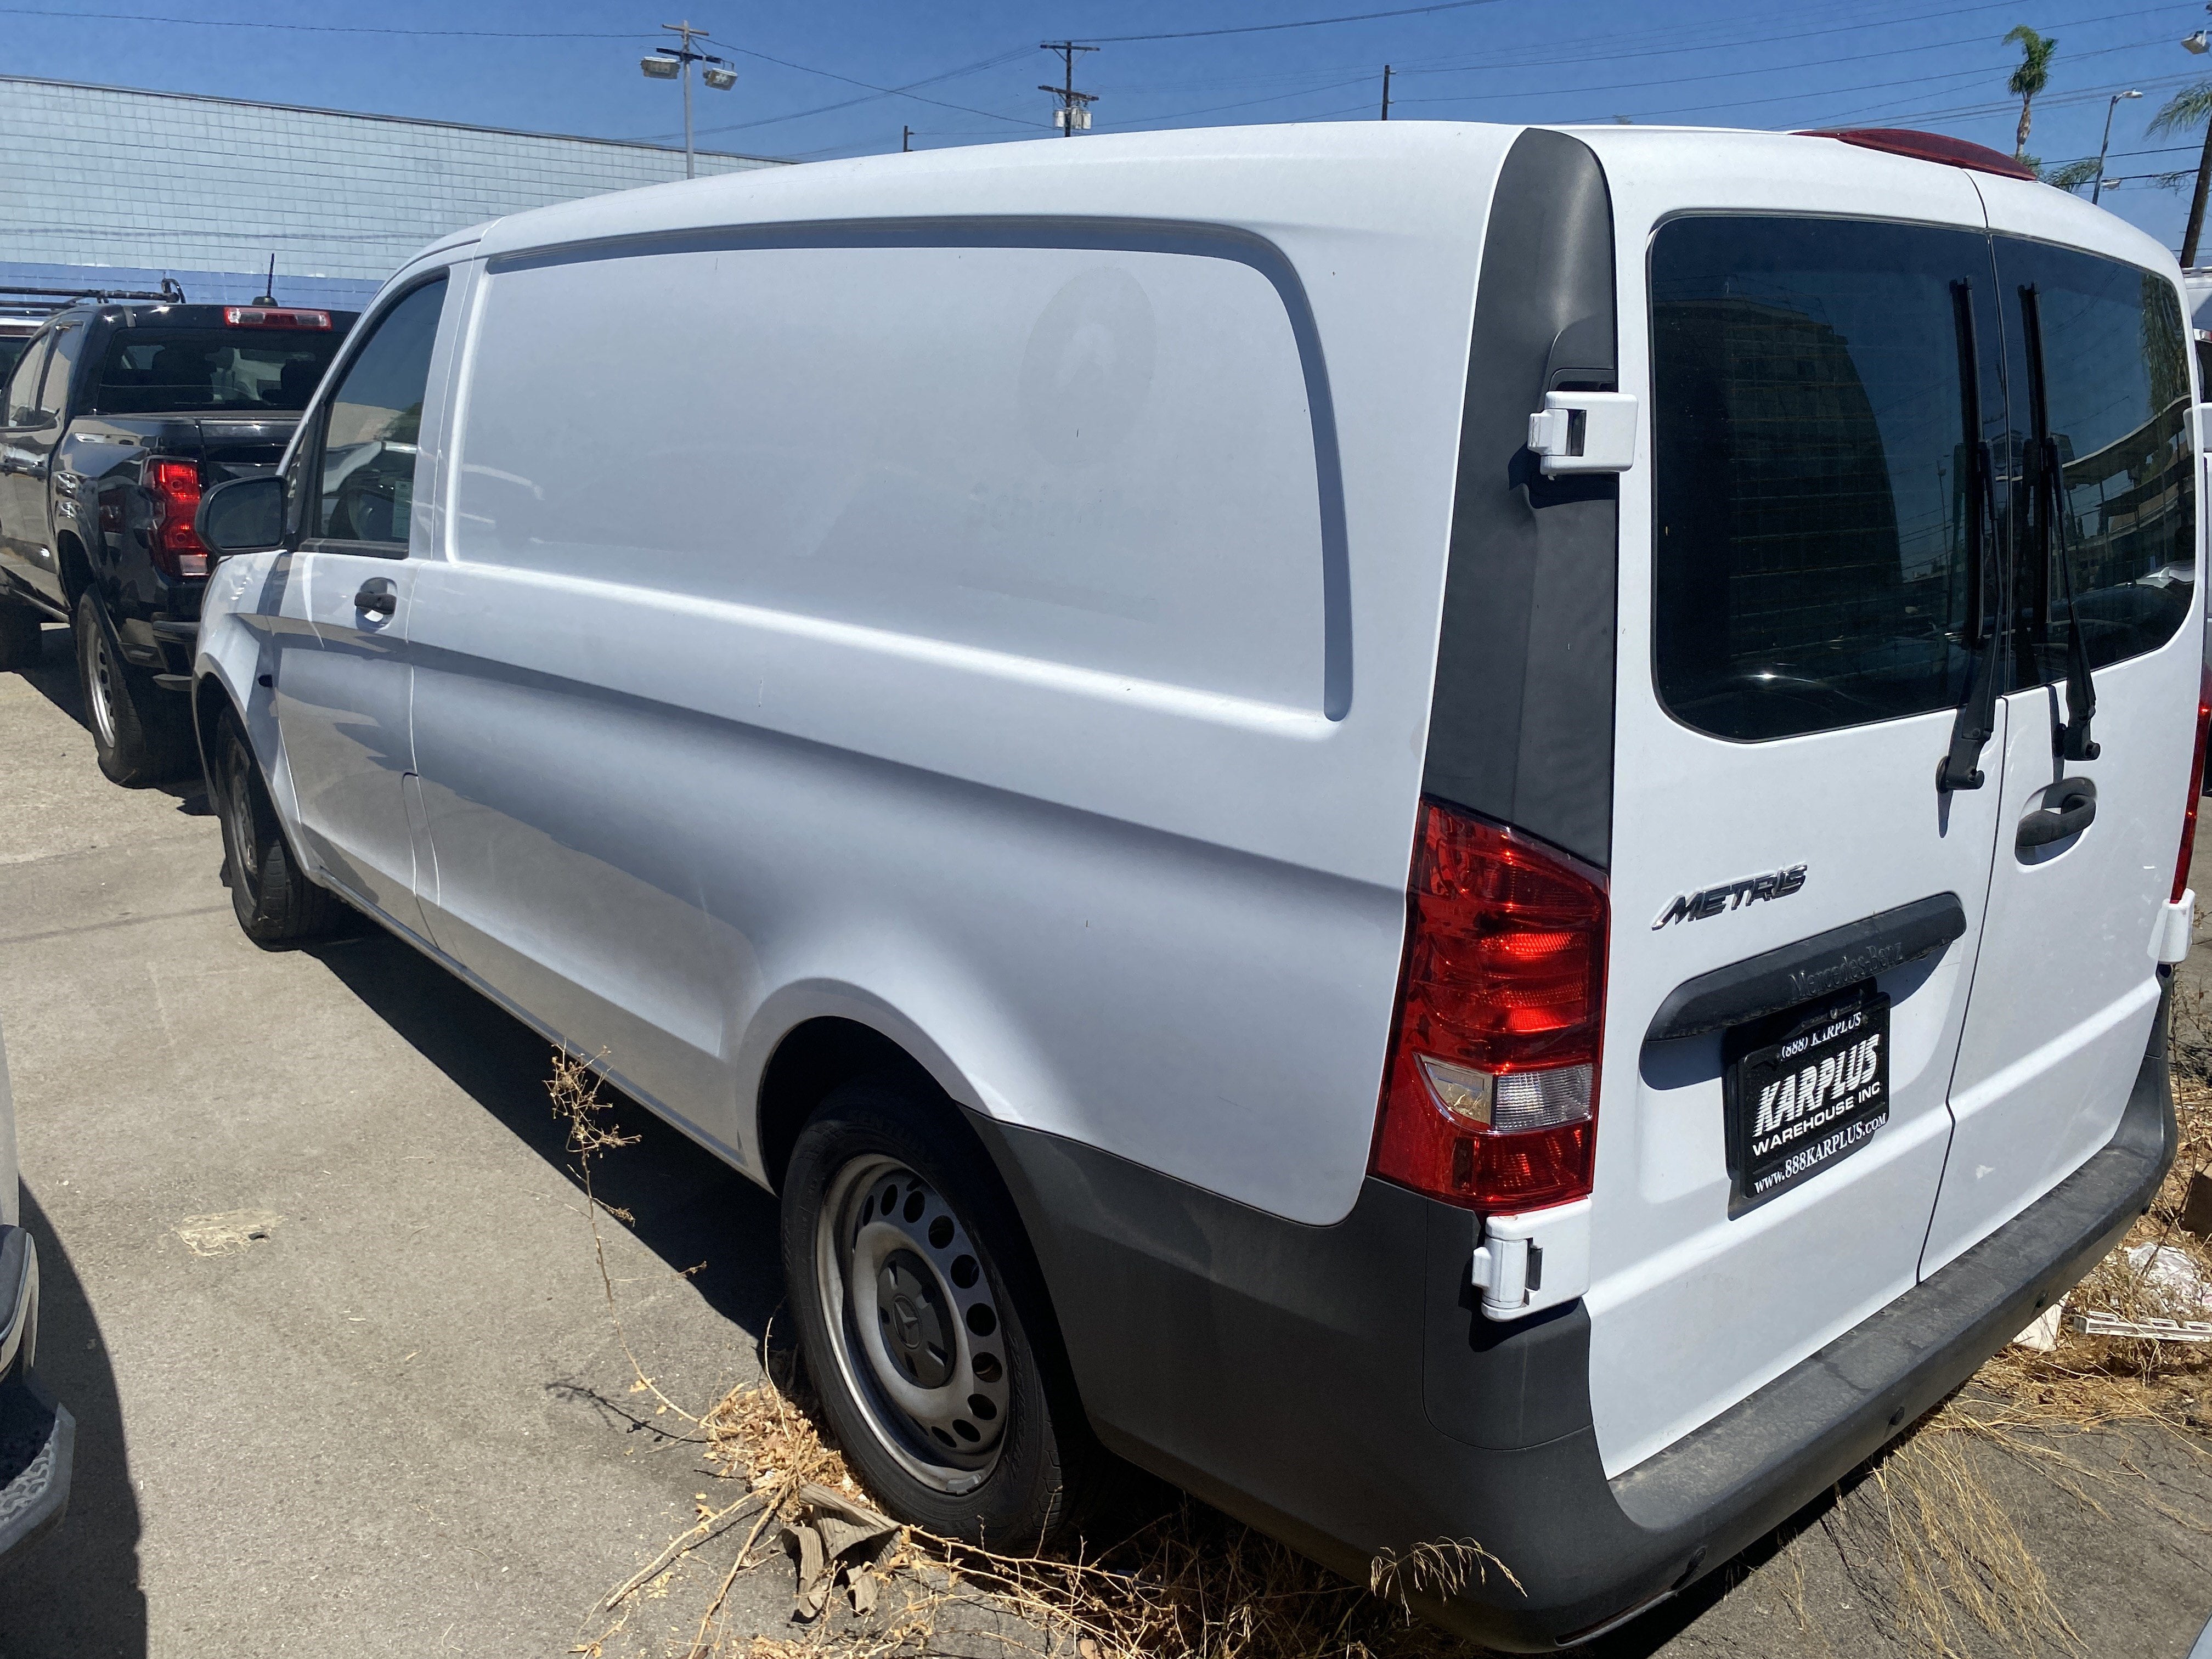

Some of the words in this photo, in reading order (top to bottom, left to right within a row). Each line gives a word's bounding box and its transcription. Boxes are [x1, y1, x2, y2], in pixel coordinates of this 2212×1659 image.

[1651, 864, 1807, 931] METRIS
[1788, 941, 1904, 1003] Mercedes-Benz
[1781, 1037, 1808, 1059] (888)
[1810, 1012, 1861, 1047] KARPLUS
[1752, 1034, 1880, 1137] KARPLUS
[1752, 1096, 1854, 1156] WAREHOUSE
[1858, 1081, 1881, 1103] INC
